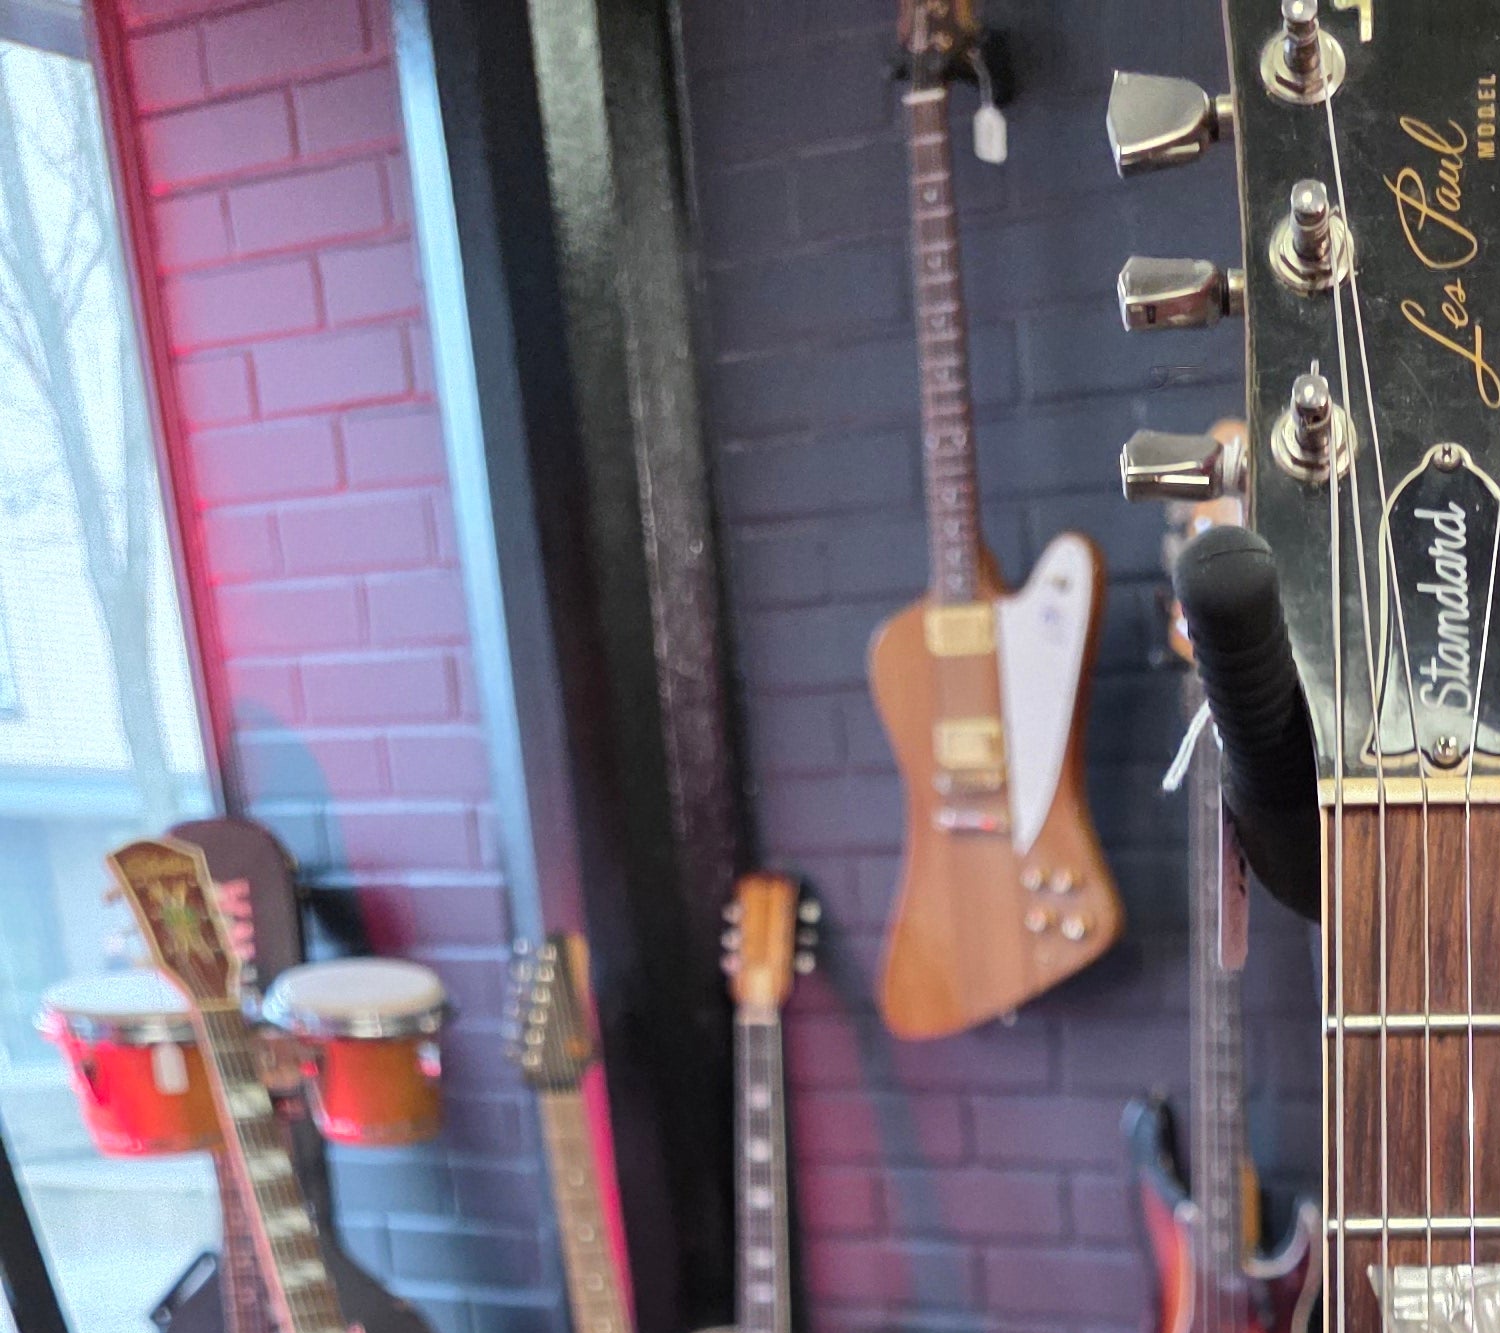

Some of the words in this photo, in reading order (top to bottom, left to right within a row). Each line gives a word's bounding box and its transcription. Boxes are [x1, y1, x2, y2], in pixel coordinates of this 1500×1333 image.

[1383, 116, 1478, 269] Paul
[1477, 73, 1497, 160] MODEL
[1413, 500, 1473, 713] Standard
